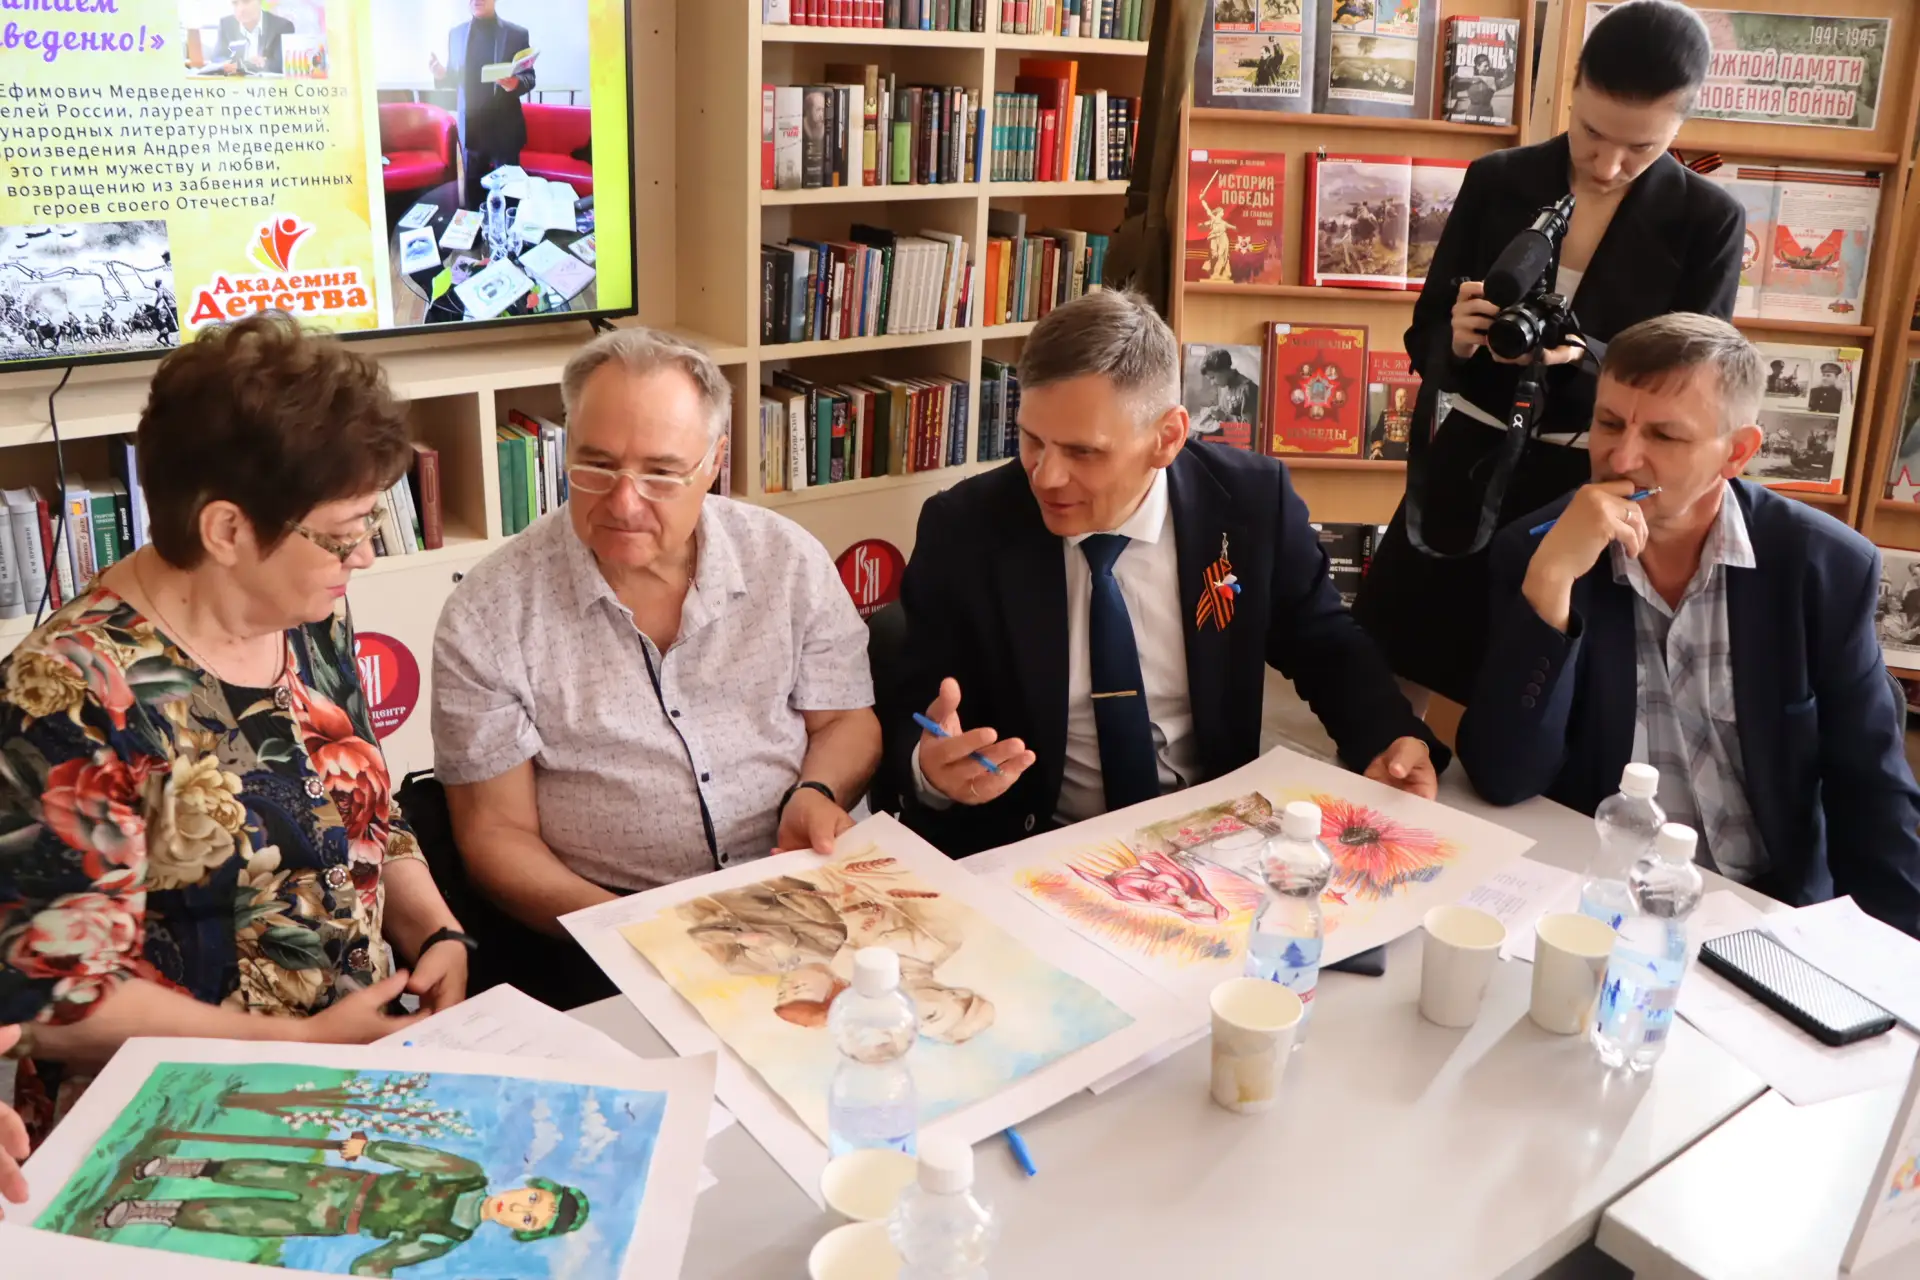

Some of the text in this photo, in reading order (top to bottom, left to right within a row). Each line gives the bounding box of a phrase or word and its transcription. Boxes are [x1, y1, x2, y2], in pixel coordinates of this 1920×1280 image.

[0, 0, 118, 13] итаем
[1457, 20, 1516, 41] ИСТОРИЯ
[1809, 26, 1878, 48] 1941-1945
[0, 22, 165, 62] веденко!»
[1708, 51, 1863, 83] ИЖНОЙ ПАМЯТИ
[110, 84, 226, 101] Медведенко
[246, 86, 288, 98] член
[294, 84, 348, 97] Союза
[1276, 80, 1301, 88] СМЕРТЬ
[0, 103, 49, 118] елей
[140, 105, 214, 121] лауреат
[221, 104, 330, 119] престижных
[1700, 86, 1853, 117] НОВЕНИЯ ВОЙНЫ
[0, 119, 330, 141] ународных литературных премий.
[0, 145, 136, 161] роизведения
[144, 142, 211, 158] Андрея
[217, 139, 325, 155] Медведенко
[11, 166, 43, 178] это
[51, 164, 99, 177] гимн
[106, 162, 195, 179] мужеству
[201, 162, 211, 172] и
[8, 174, 353, 199] возвращению из забвения истинных
[1218, 174, 1274, 191] ИСТОРИЯ
[33, 193, 275, 218] героев своего Отечества!
[1221, 189, 1274, 208] ПОБЕДЫ
[213, 271, 357, 295] Академия
[190, 286, 368, 324] Детства
[104, 532, 113, 567] ПАДЕНИЕ
[371, 706, 406, 720] ЦЕНТР
